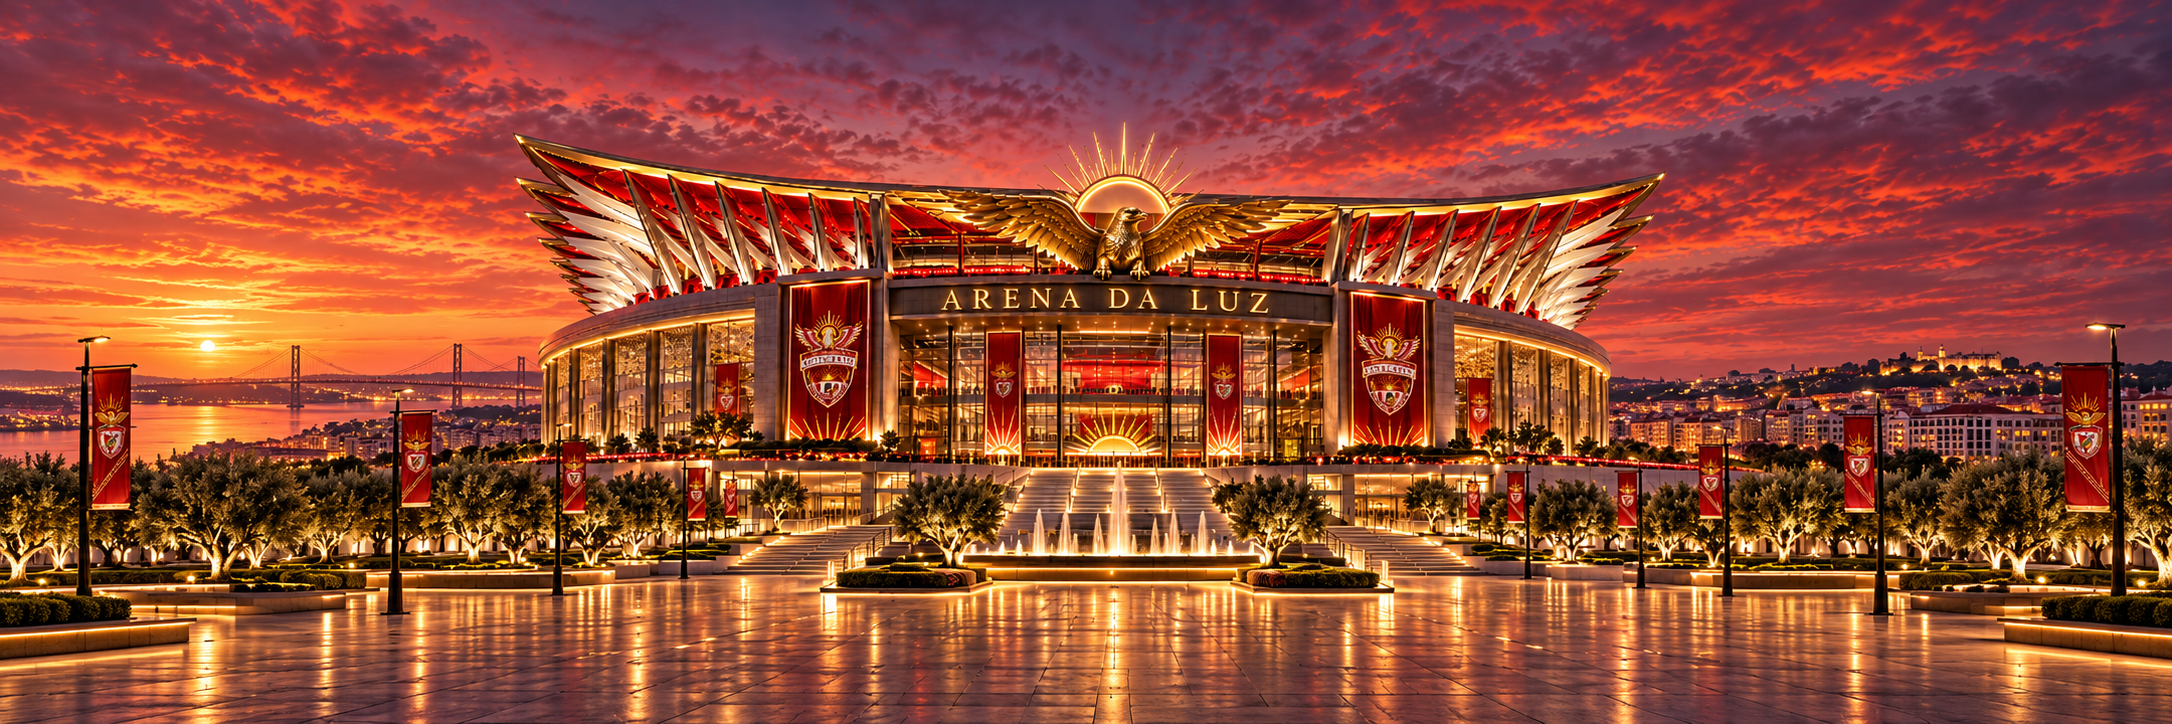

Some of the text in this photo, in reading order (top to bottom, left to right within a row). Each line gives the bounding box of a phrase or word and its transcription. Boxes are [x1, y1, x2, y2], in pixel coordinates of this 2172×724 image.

[941, 288, 1269, 313] ARENA DA LUZ
